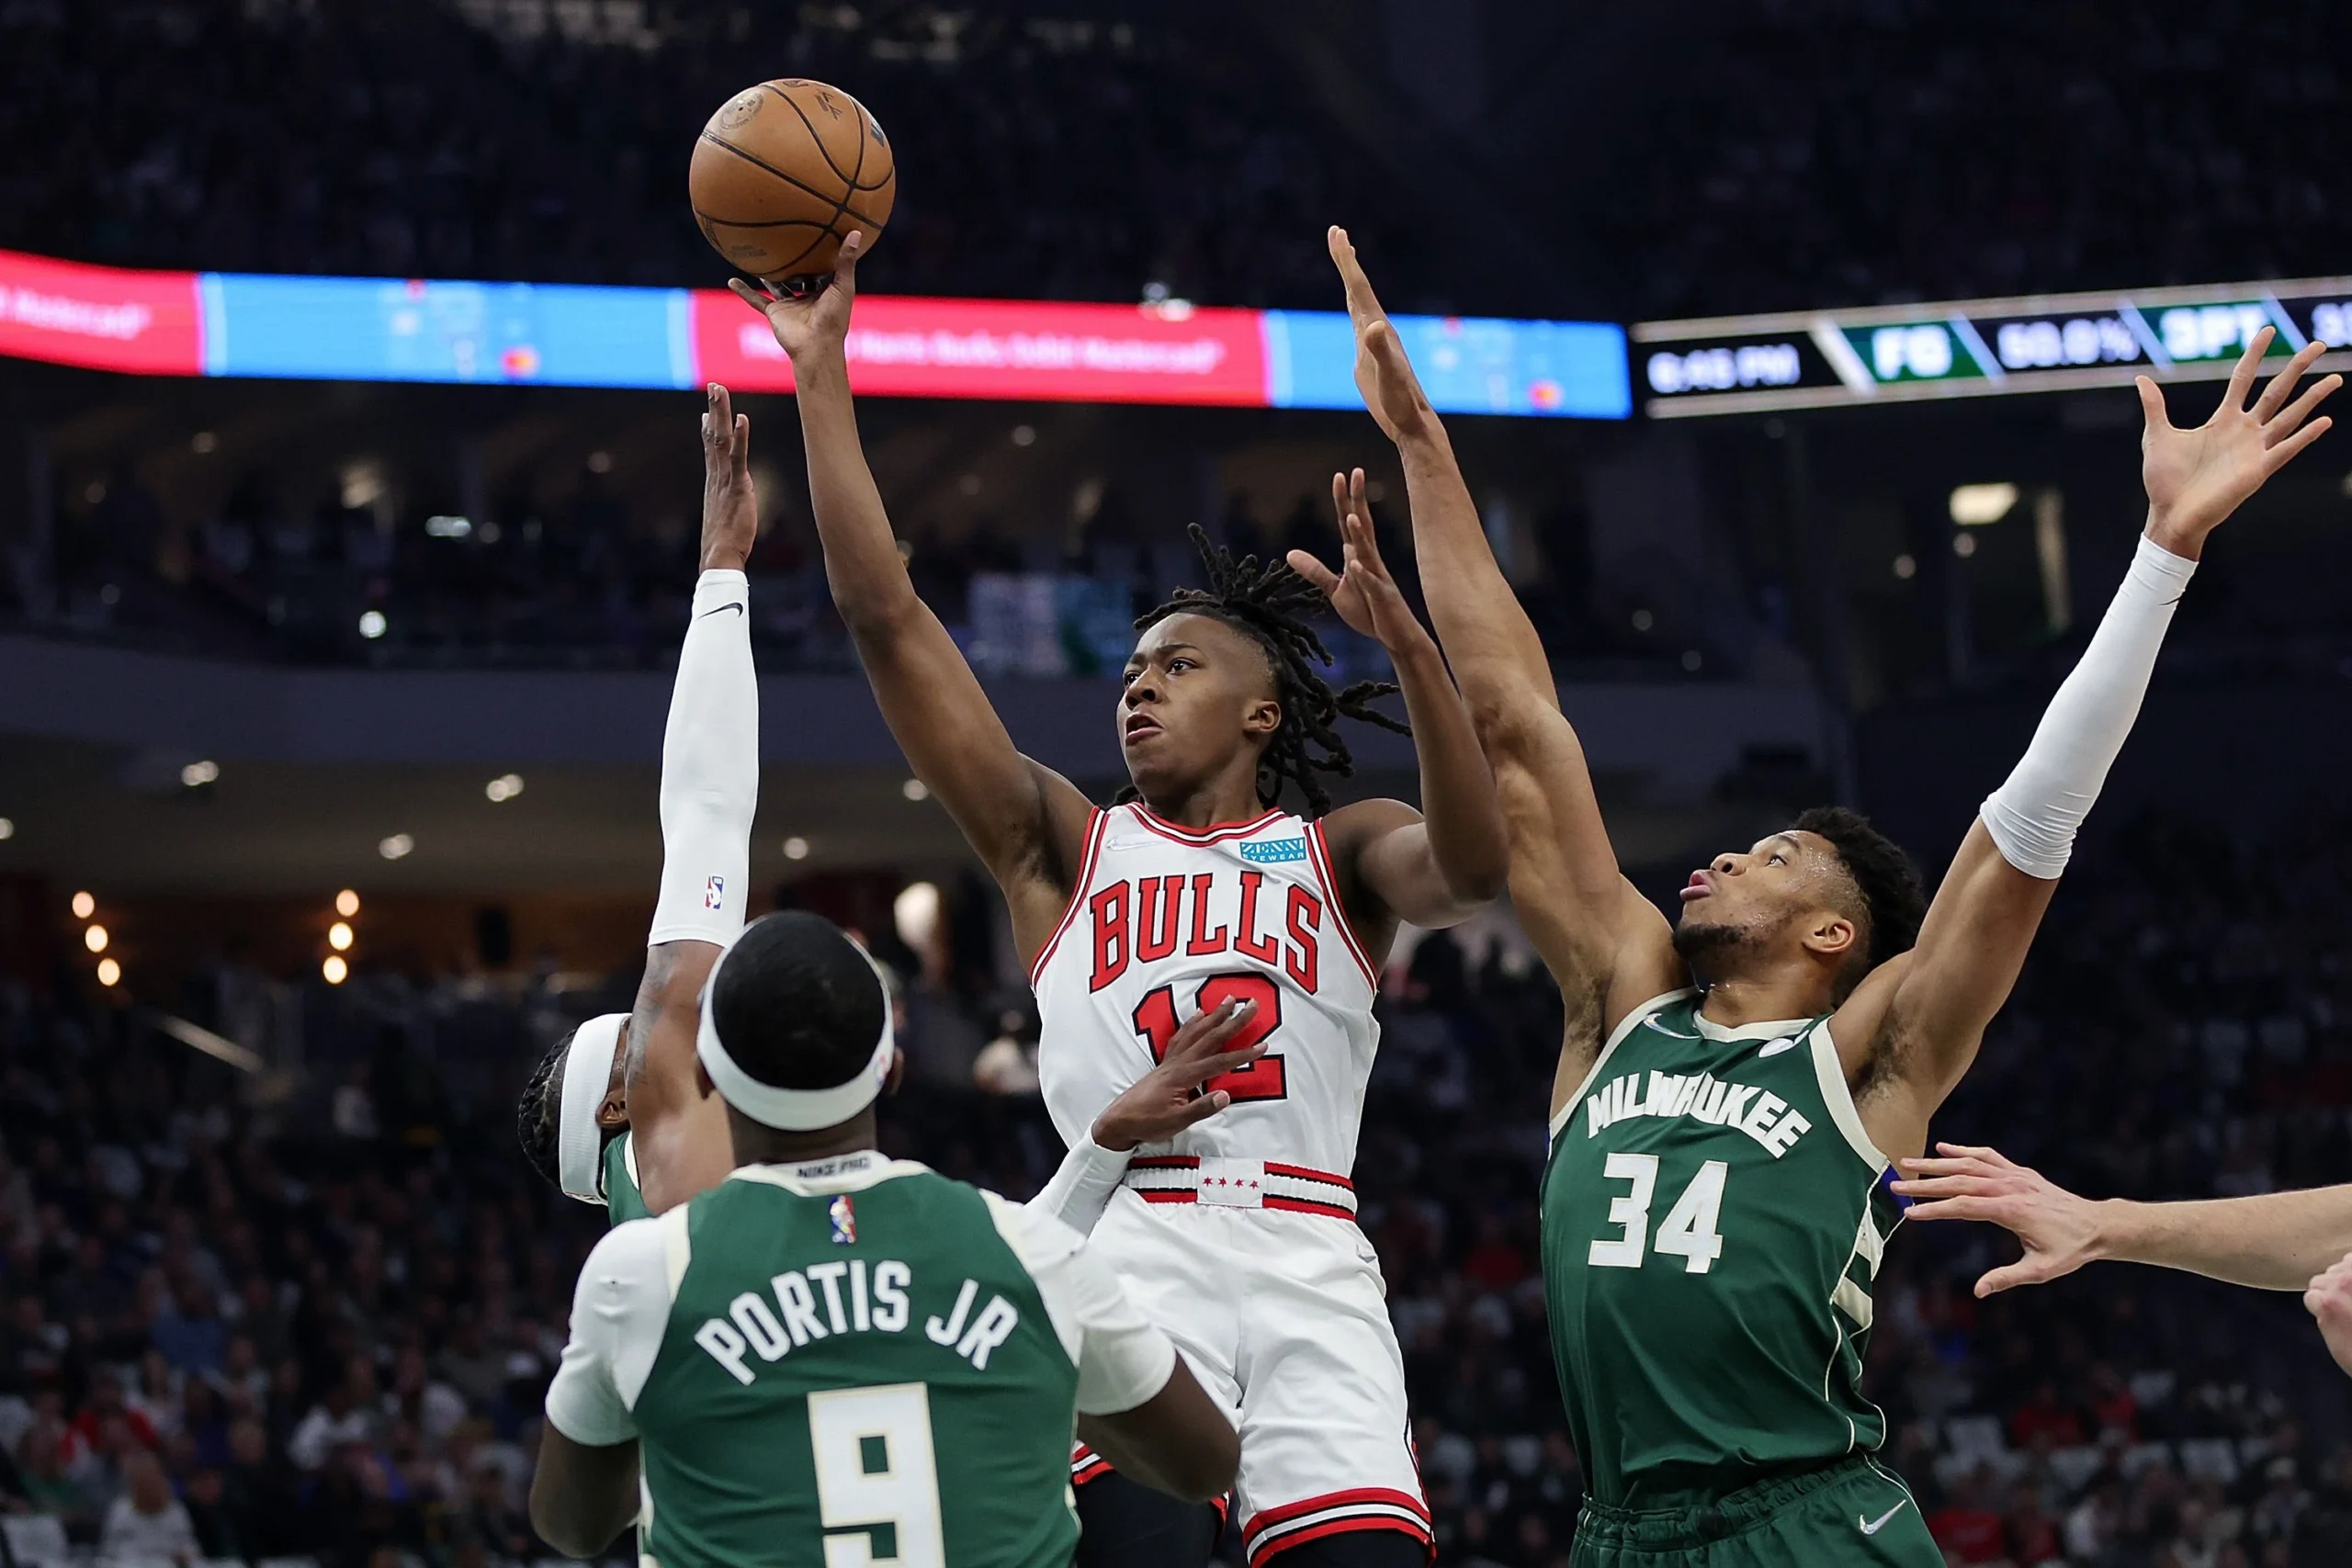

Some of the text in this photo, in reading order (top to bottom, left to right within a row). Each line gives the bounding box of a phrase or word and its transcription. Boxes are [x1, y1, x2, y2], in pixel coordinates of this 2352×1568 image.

[1241, 839, 1304, 853] ZENNI
[1242, 852, 1304, 861] EYEWEAR
[1090, 871, 1323, 995] BULLS
[1132, 971, 1288, 1104] 12
[1587, 1070, 1813, 1159] MILWAUKEE
[1588, 1152, 1729, 1274] 34
[694, 1259, 1019, 1385] PORTIS JR
[807, 1381, 947, 1568] 9
